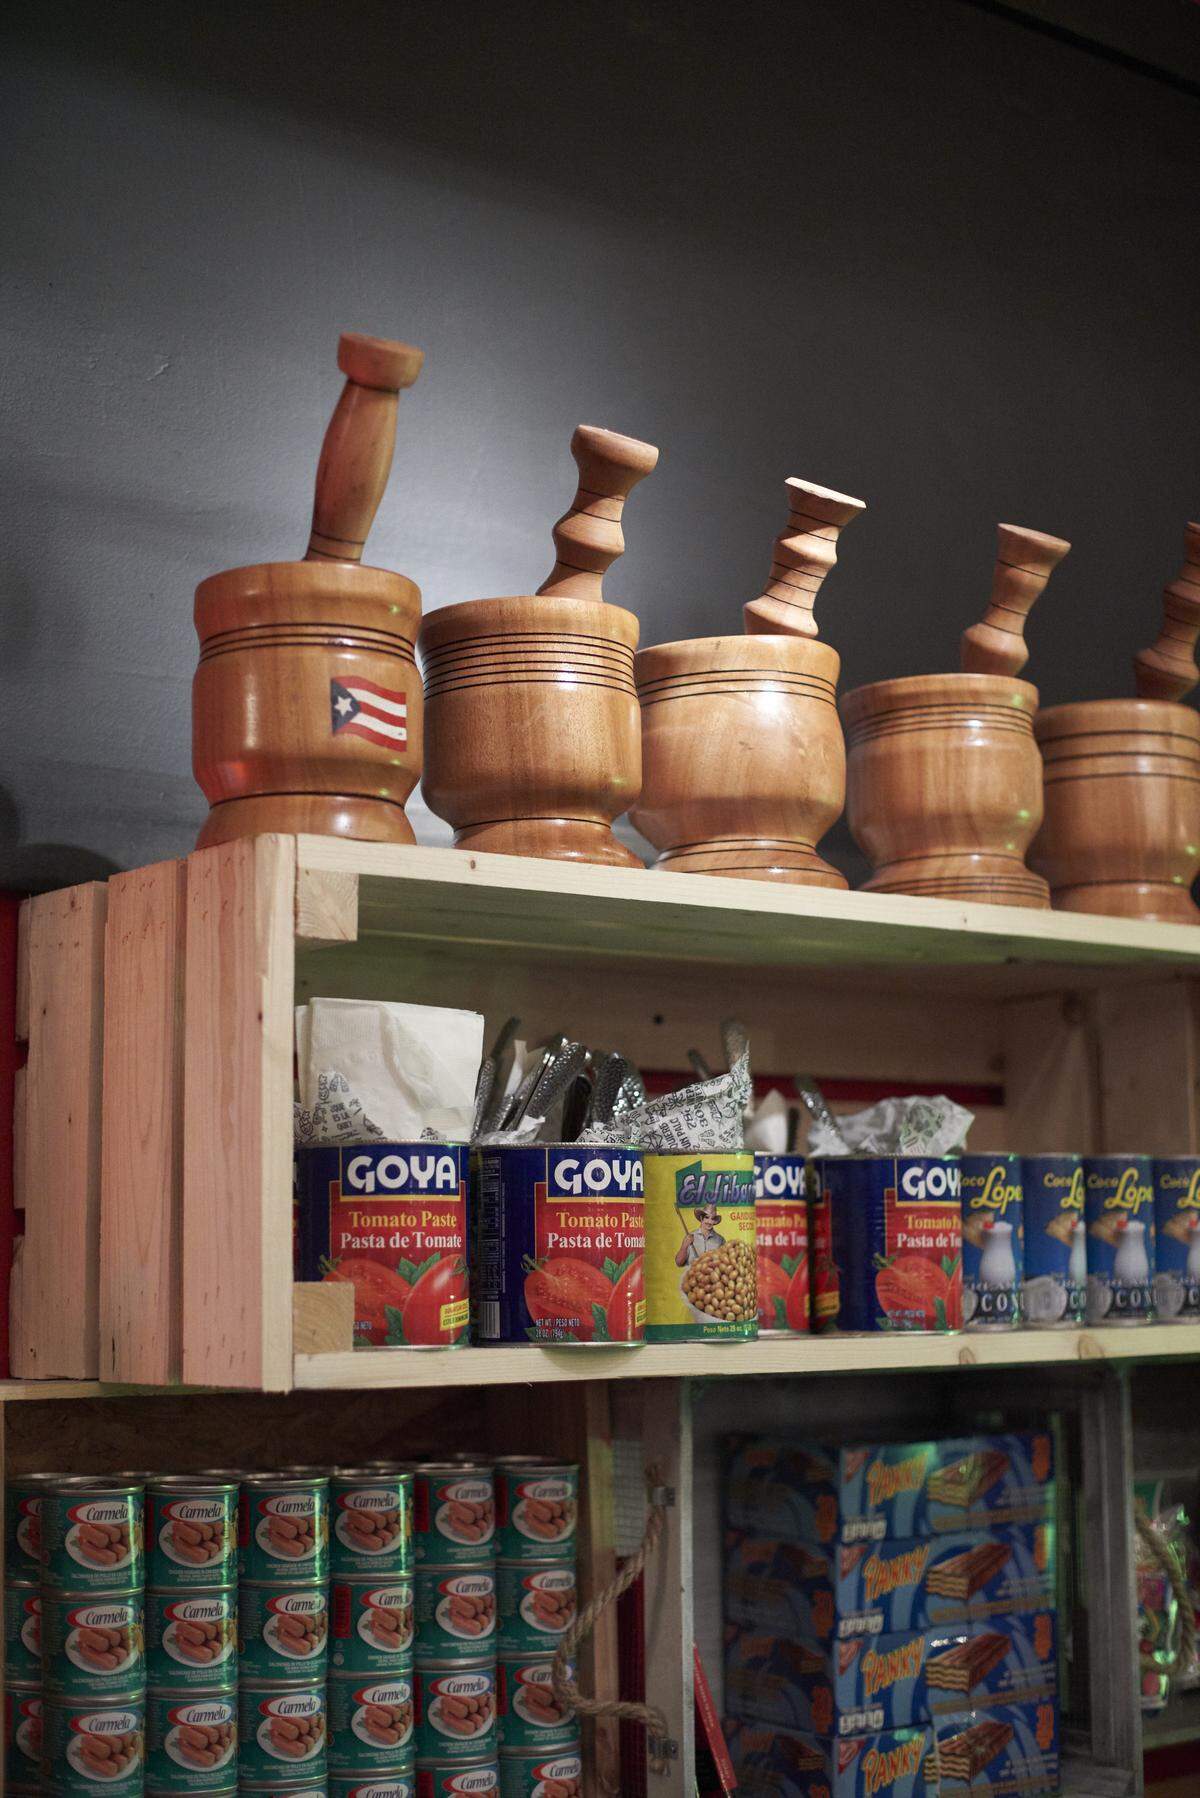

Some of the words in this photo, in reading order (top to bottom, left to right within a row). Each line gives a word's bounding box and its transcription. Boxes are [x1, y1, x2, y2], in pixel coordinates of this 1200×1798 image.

[346, 1155, 456, 1193] GOYA
[554, 1159, 643, 1194] GOYA
[679, 1173, 706, 1205] El
[349, 1211, 417, 1228] Tomato
[421, 1211, 457, 1228] Paste
[556, 1212, 618, 1228] Tomato
[904, 1214, 952, 1230] Tomato
[341, 1232, 385, 1249] Pasta
[389, 1232, 410, 1248] de
[412, 1231, 462, 1248] Tomate
[547, 1232, 592, 1248] Pasta
[595, 1232, 612, 1248] de
[774, 1231, 789, 1247] de
[897, 1232, 934, 1249] Pasta
[935, 1231, 950, 1248] de
[275, 1497, 315, 1513] Carmela
[353, 1493, 394, 1508] Carmela
[86, 1506, 128, 1522] Carmela
[178, 1503, 223, 1519] Carmela
[86, 1606, 128, 1625] Carmela
[183, 1602, 224, 1619] Carmela
[861, 1636, 926, 1697] PANKY
[447, 1678, 485, 1694] Carmela
[186, 1706, 227, 1723] Carmela
[277, 1698, 317, 1715] Carmela
[88, 1714, 132, 1732] Carmela
[861, 1732, 927, 1795] PANKY
[460, 1773, 494, 1790] Carmela
